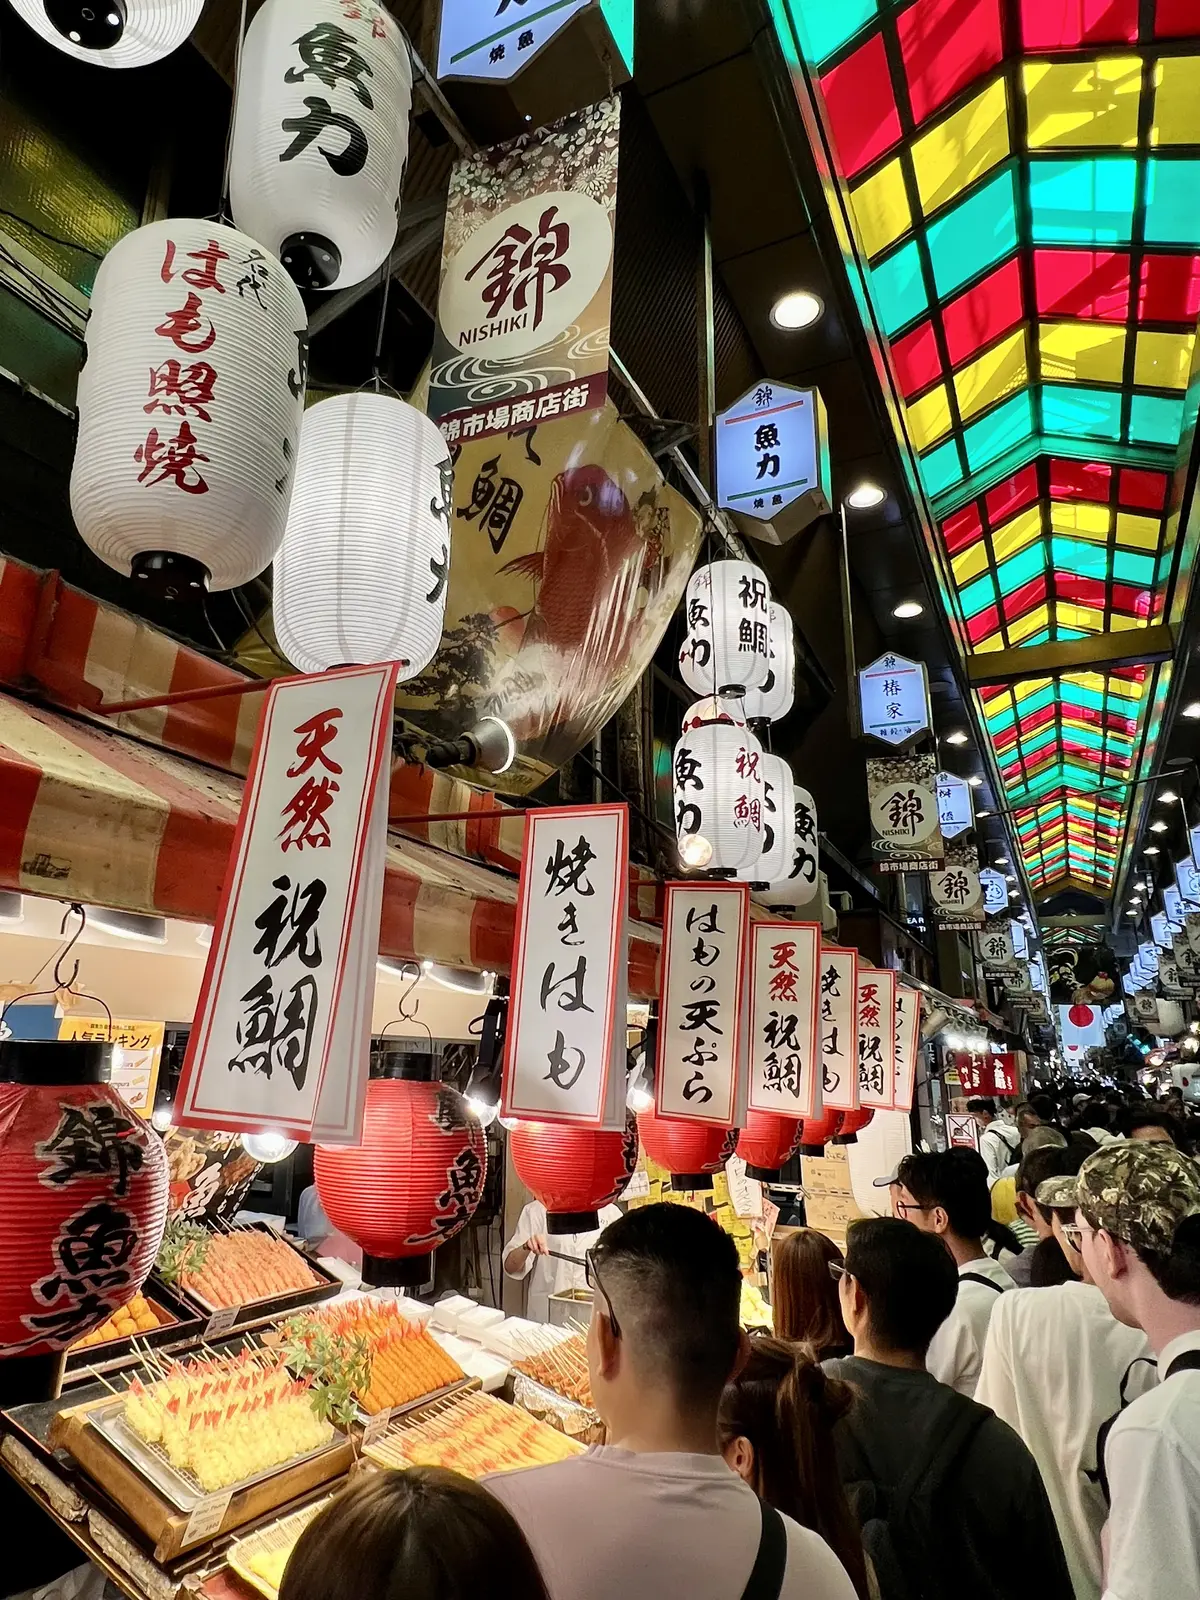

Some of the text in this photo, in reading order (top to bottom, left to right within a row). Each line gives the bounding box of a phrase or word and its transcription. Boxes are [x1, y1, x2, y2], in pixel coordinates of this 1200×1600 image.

[489, 29, 535, 65] 焼魚
[280, 22, 374, 176] 魚力
[465, 205, 572, 333] 錦
[133, 239, 230, 495] はも照焼
[458, 313, 528, 348] NISHIKI
[440, 384, 590, 444] 錦市場商店街
[752, 385, 773, 407] 錦
[754, 423, 780, 480] 魚力
[688, 598, 711, 672] 魚力
[738, 575, 768, 659] 祝鯛
[882, 679, 904, 720] 椿家
[675, 747, 704, 836] 魚力
[734, 746, 762, 833] 祝鯛
[880, 788, 925, 837] 錦
[787, 803, 817, 884] 魚力
[882, 828, 910, 837] NISHIKI
[228, 707, 344, 1092] 天然祝鯛
[937, 870, 970, 905] 錦
[540, 835, 597, 1091] 焼きはも
[985, 936, 1007, 960] 錦
[679, 904, 726, 1104] はもの天ぷら
[763, 941, 802, 1099] 天然祝鯛
